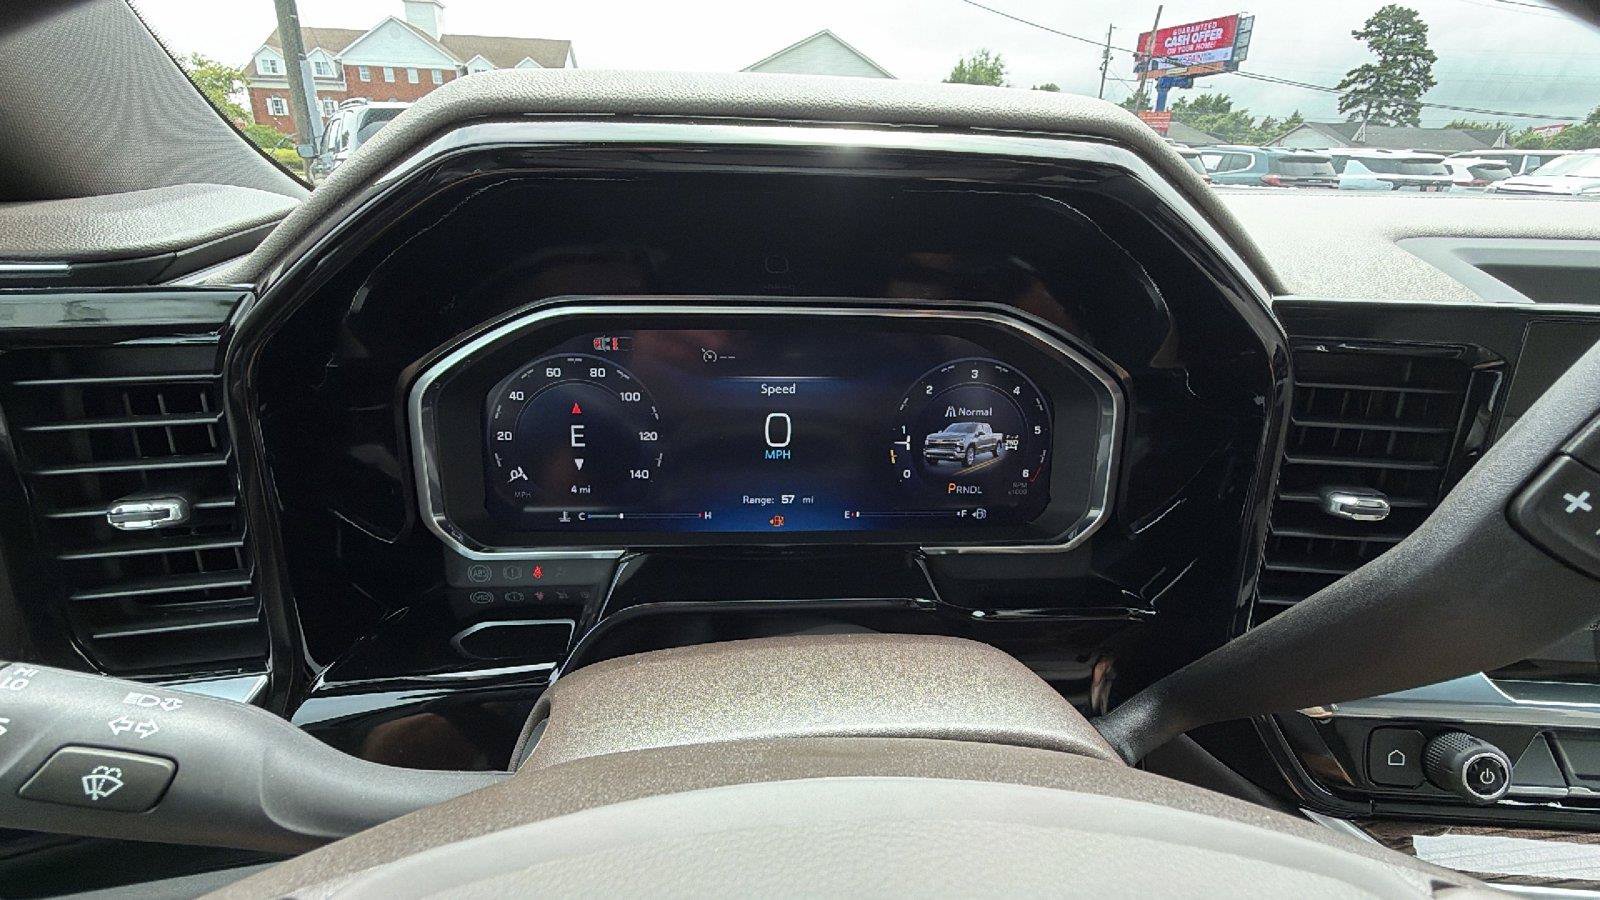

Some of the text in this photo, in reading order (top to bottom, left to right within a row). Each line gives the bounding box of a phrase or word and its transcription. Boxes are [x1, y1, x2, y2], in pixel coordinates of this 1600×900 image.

[1173, 22, 1217, 35] GUARANTEED
[1165, 28, 1224, 48] CASH OFFER
[1178, 45, 1194, 53] YOUR
[546, 367, 561, 378] 60
[589, 367, 606, 378] 80
[971, 369, 979, 379] 3
[760, 383, 796, 396] Speed
[926, 385, 933, 395] 2
[1013, 386, 1021, 395] 4
[509, 391, 524, 401] 40
[619, 391, 641, 402] 100
[958, 407, 992, 417] Normal
[765, 412, 792, 448] 0
[901, 425, 906, 434] 1
[1034, 426, 1042, 435] 5
[497, 431, 513, 441] 20
[571, 425, 586, 448] E
[639, 431, 658, 441] 120
[765, 450, 791, 460] MPH
[630, 469, 650, 479] 140
[903, 469, 911, 478] 0
[1022, 469, 1029, 478] 6
[571, 485, 591, 493] 4 mi
[742, 494, 814, 506] Range: 57 mi
[578, 511, 586, 520] C
[704, 511, 712, 520] H
[961, 509, 967, 518] F
